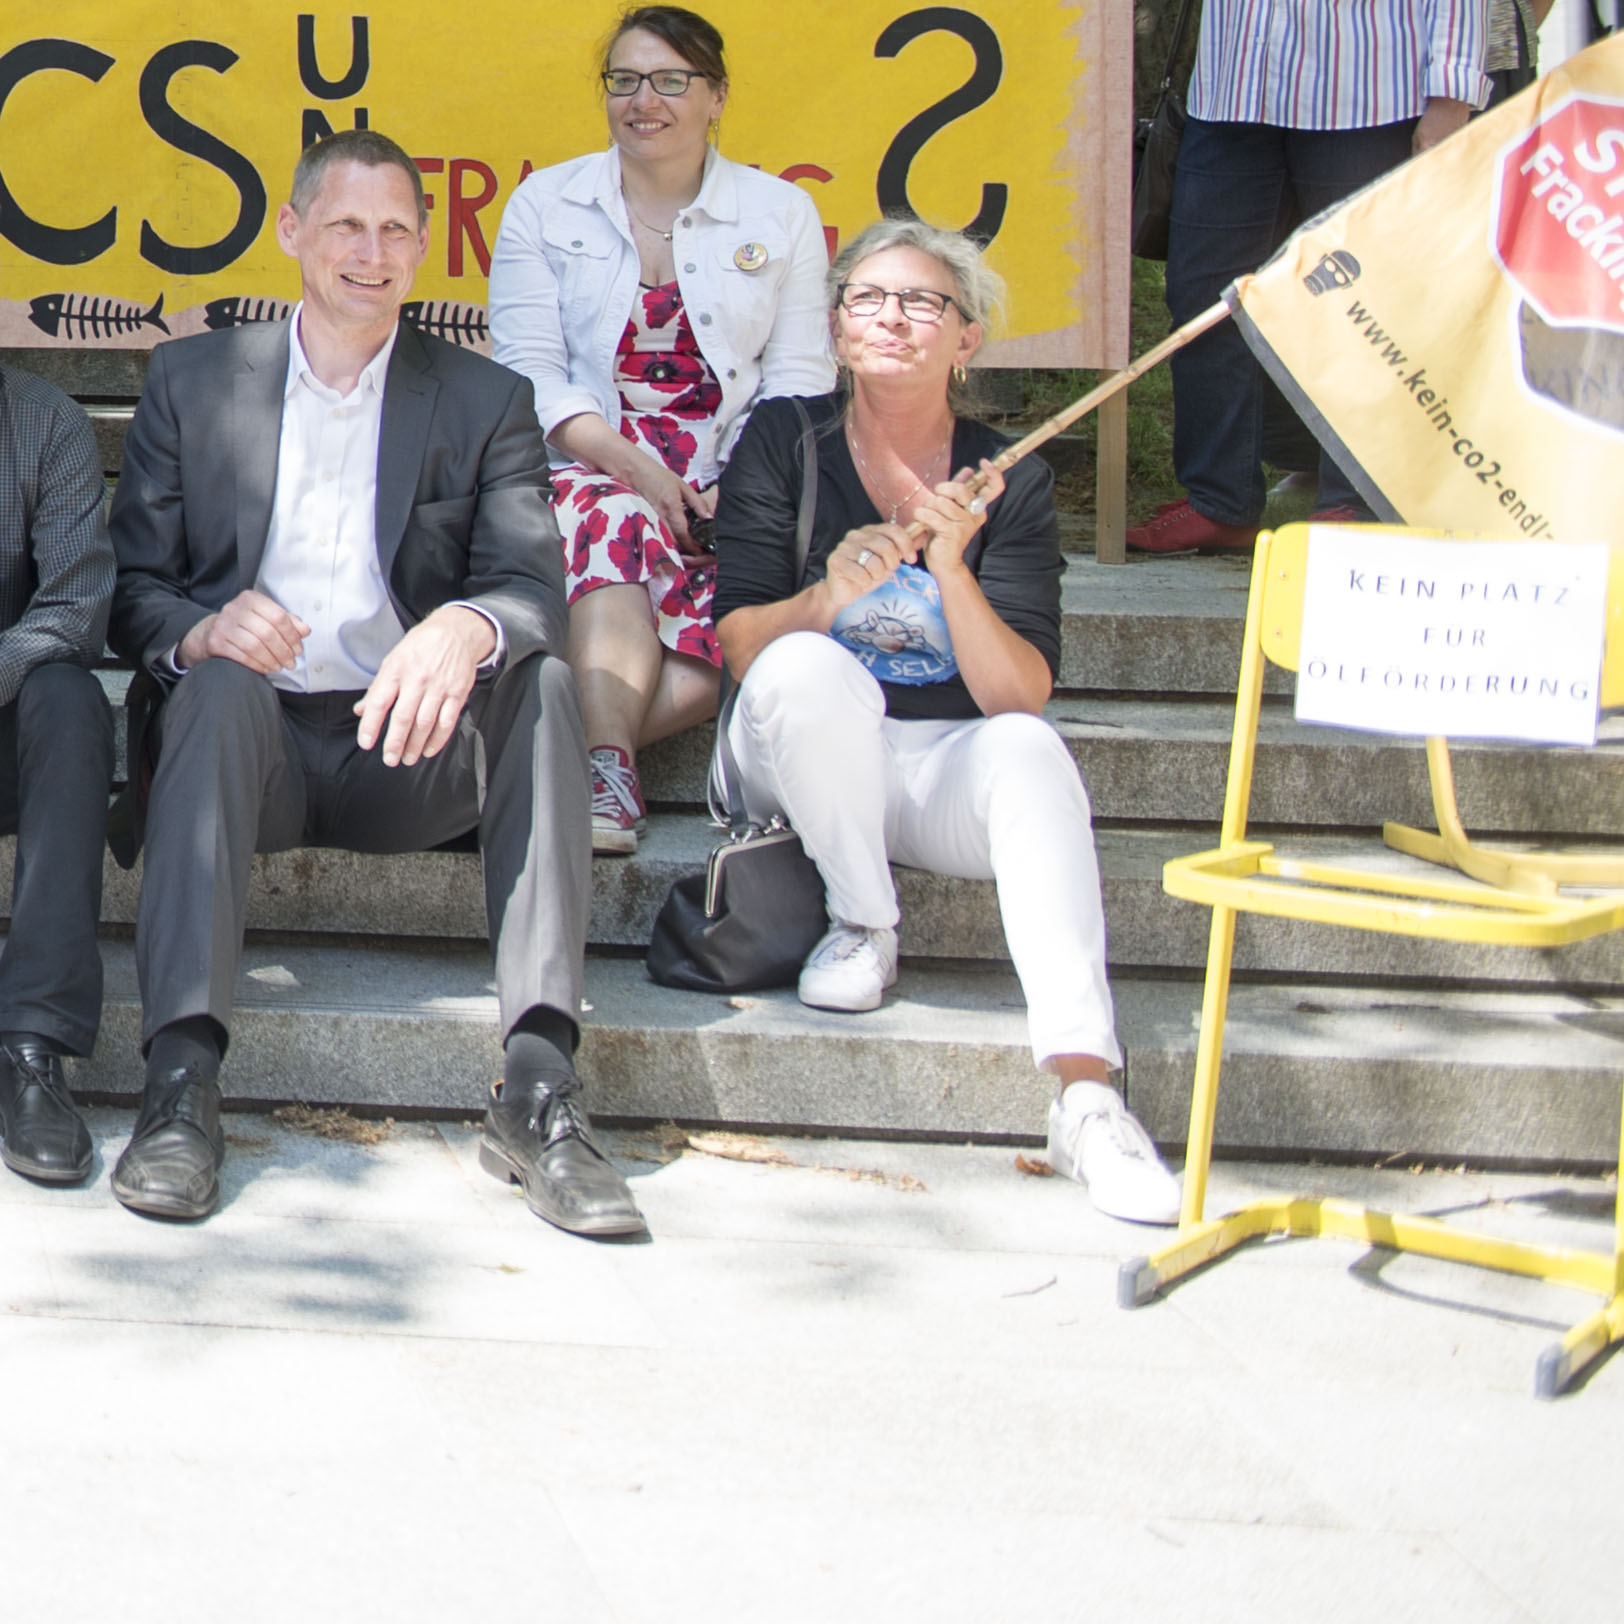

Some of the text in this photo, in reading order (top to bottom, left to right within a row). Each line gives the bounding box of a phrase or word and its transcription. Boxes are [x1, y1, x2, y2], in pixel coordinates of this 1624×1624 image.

[1346, 299, 1555, 542] www.kein-co2-endl
[1349, 568, 1570, 607] KEIN PLATZ
[1306, 655, 1590, 701] ÖLFÖRDERUNG
